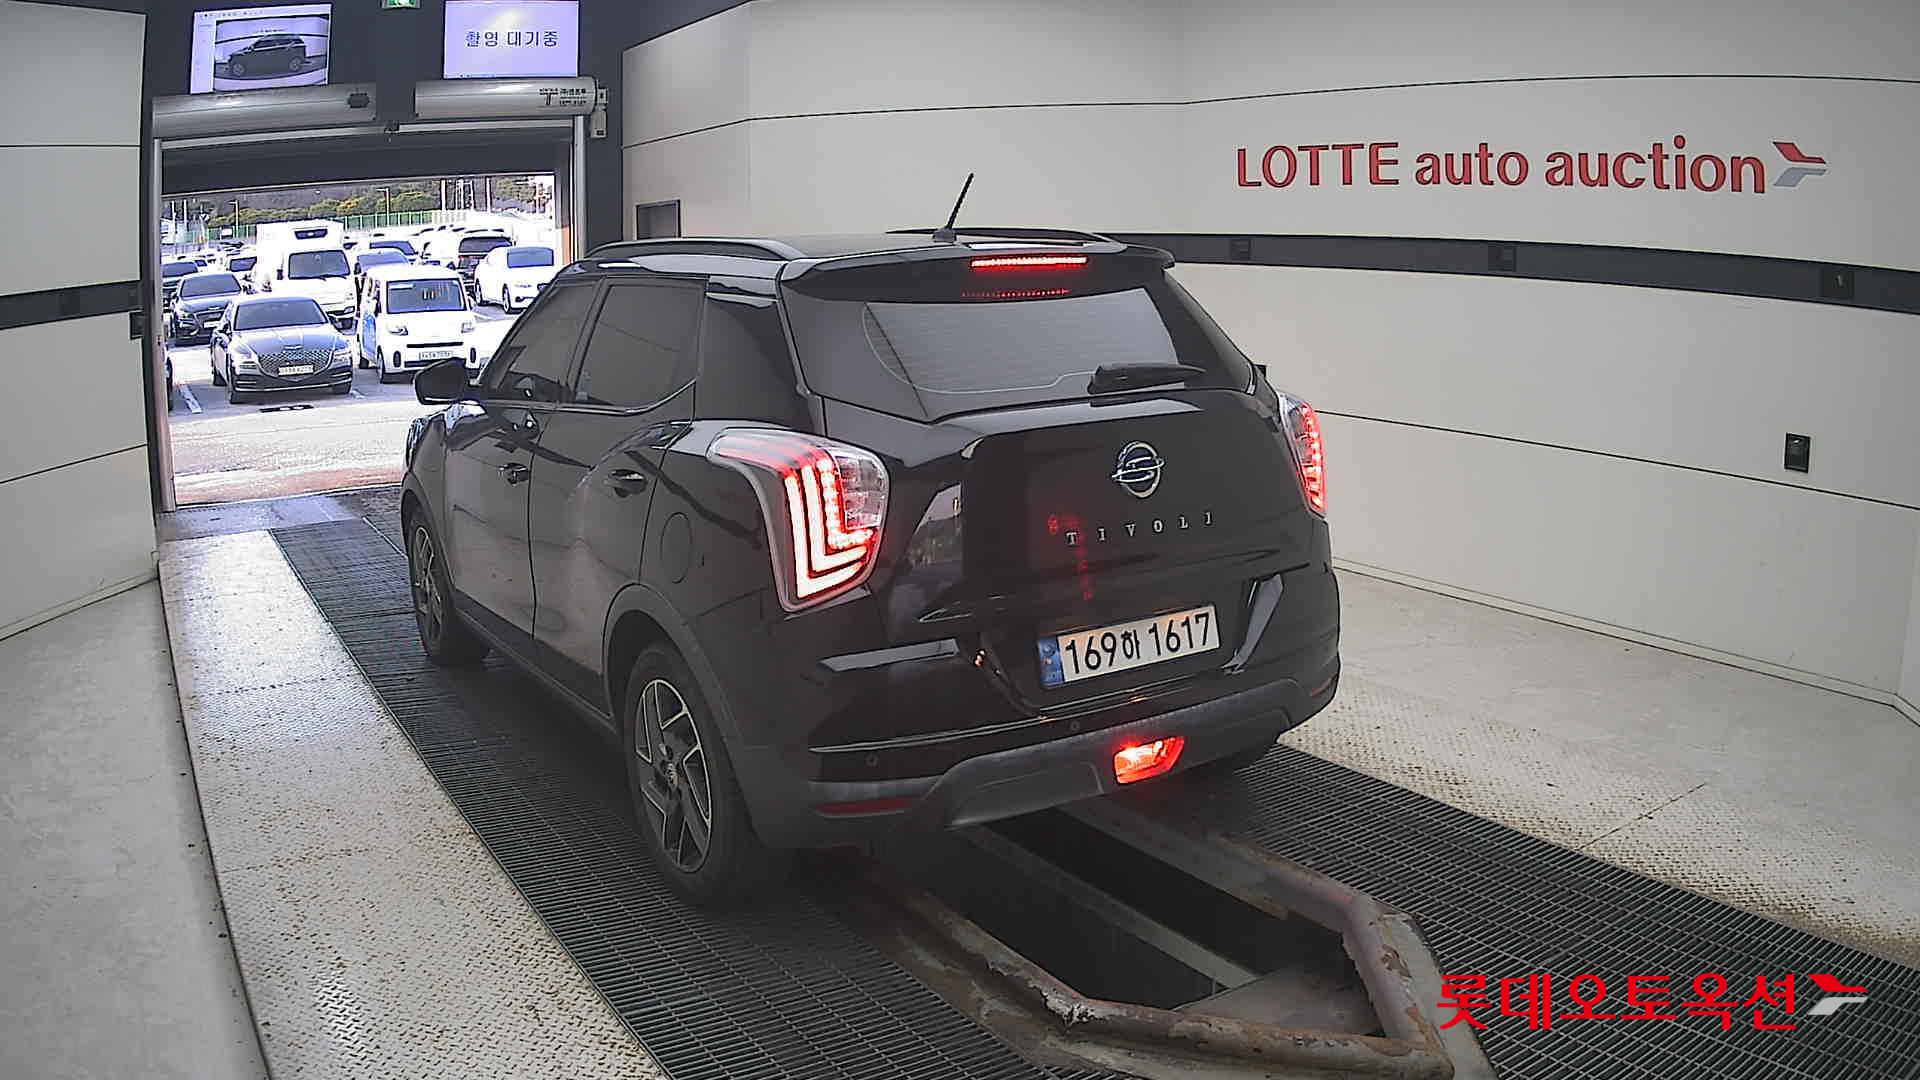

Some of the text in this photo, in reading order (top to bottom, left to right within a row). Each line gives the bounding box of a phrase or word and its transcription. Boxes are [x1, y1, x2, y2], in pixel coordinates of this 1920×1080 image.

[1236, 135, 1766, 194] LOTTE auto auction
[1065, 511, 1213, 546] TIVOLI
[1065, 612, 1210, 674] 169하 1617
